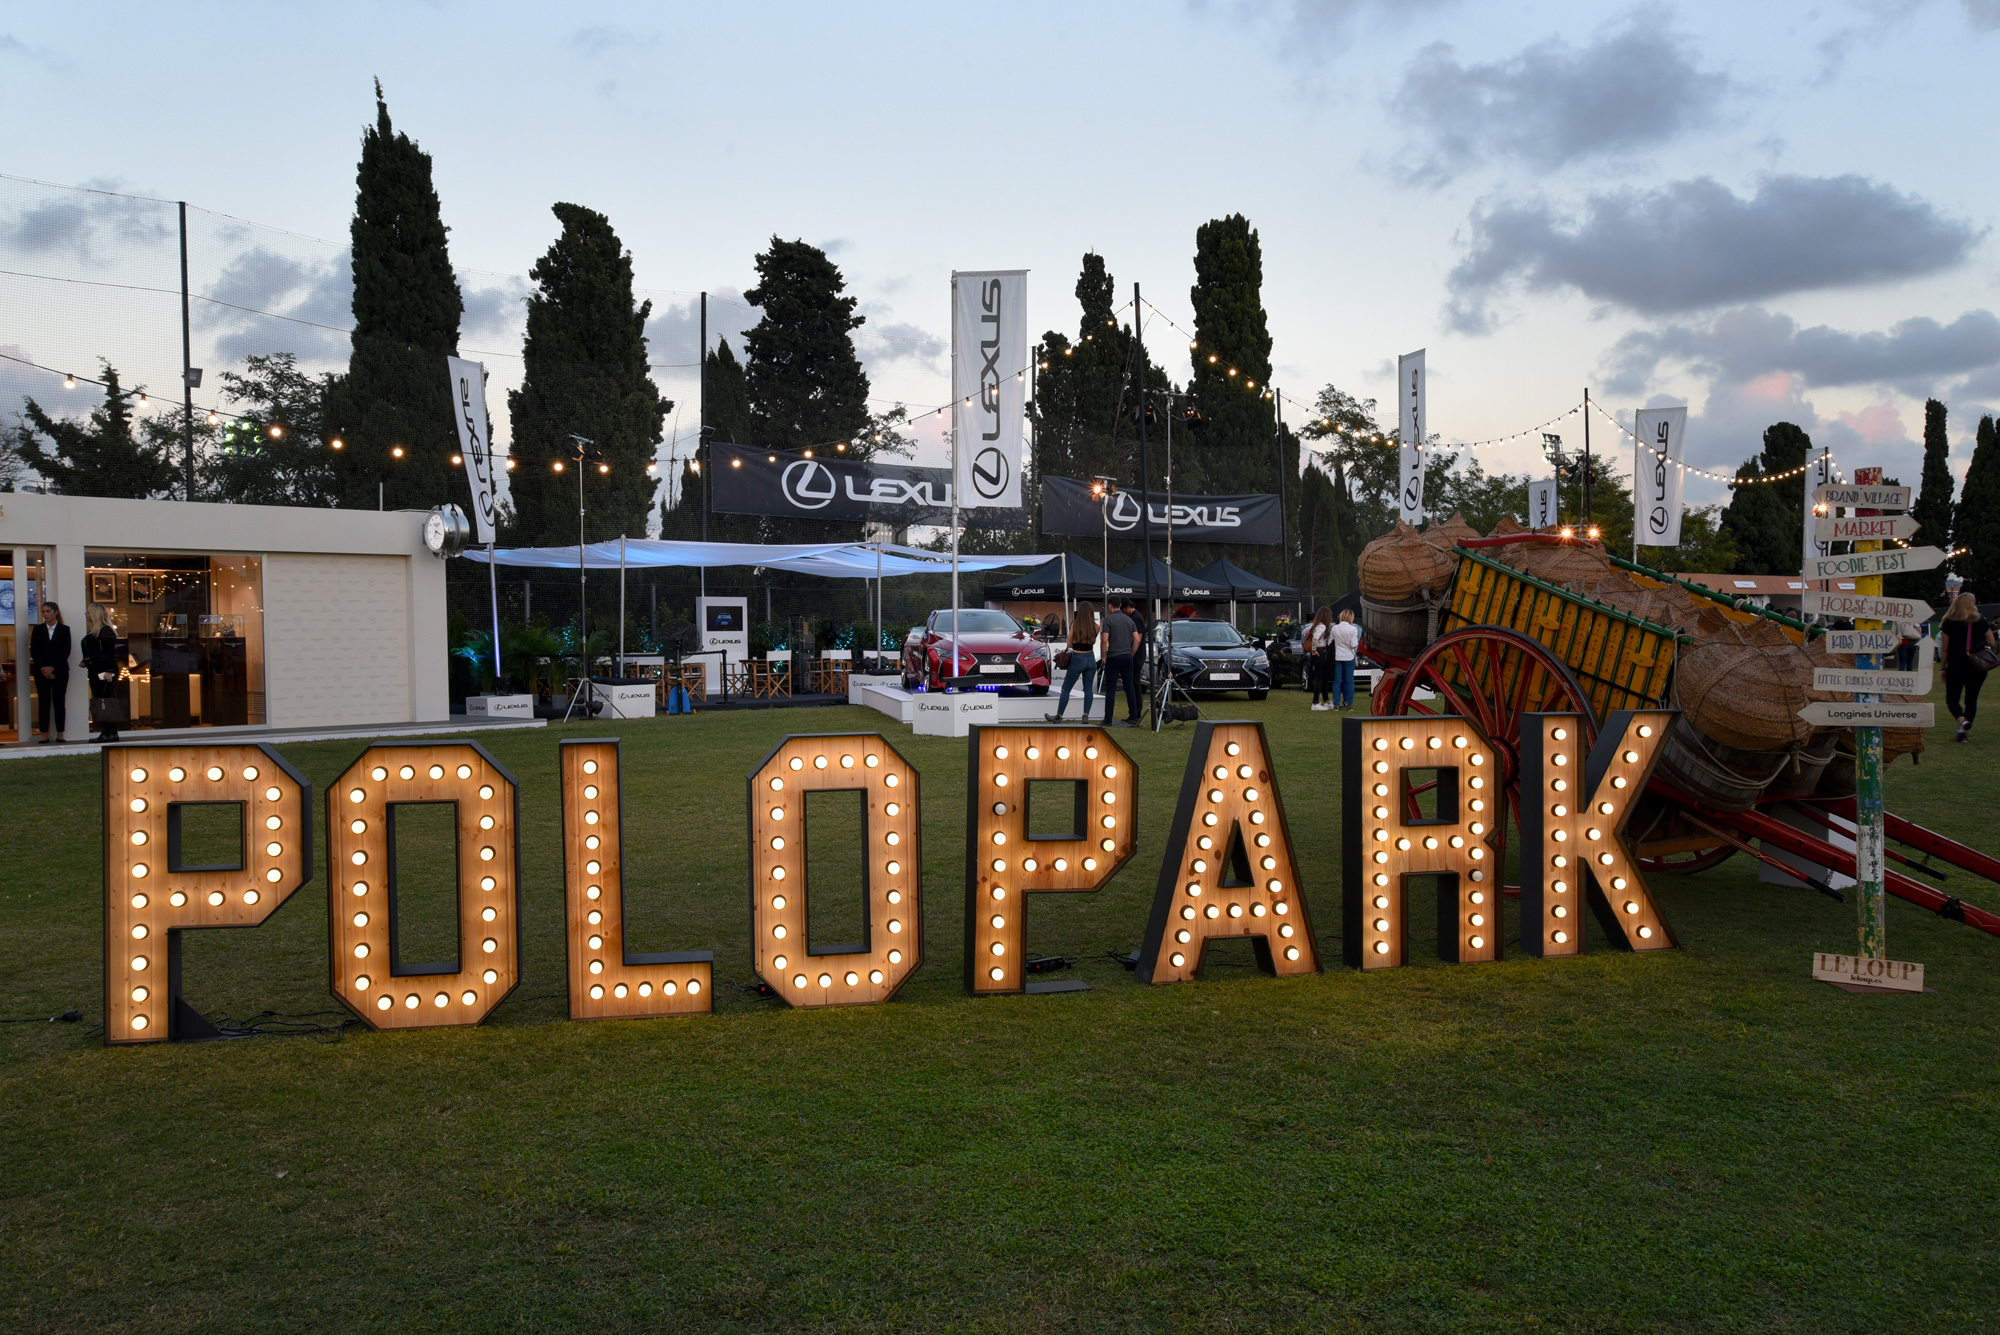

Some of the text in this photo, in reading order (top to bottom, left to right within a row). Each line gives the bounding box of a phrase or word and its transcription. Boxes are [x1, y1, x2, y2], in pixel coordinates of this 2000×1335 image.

[981, 278, 1001, 441] LEXUS
[1411, 368, 1420, 470] LEXUS
[1655, 421, 1669, 501] LEXUS
[845, 475, 953, 506] LEXU
[1825, 490, 1903, 505] BRAND VILLAGE
[1147, 503, 1242, 527] LEXUS
[1833, 519, 1897, 538] MARKET
[1816, 552, 1908, 577] FOODIE FEST
[1190, 588, 1210, 596] LEXUS
[1820, 597, 1867, 614] HORSE
[1874, 600, 1914, 619] RIDER
[1831, 634, 1893, 650] KIDS PARK
[1818, 674, 1915, 688] LITTLE RIDERS CORNER
[1827, 709, 1918, 719] Longines Universe
[1819, 954, 1917, 981] LE LOUP
[1850, 974, 1883, 985] leloup.es
